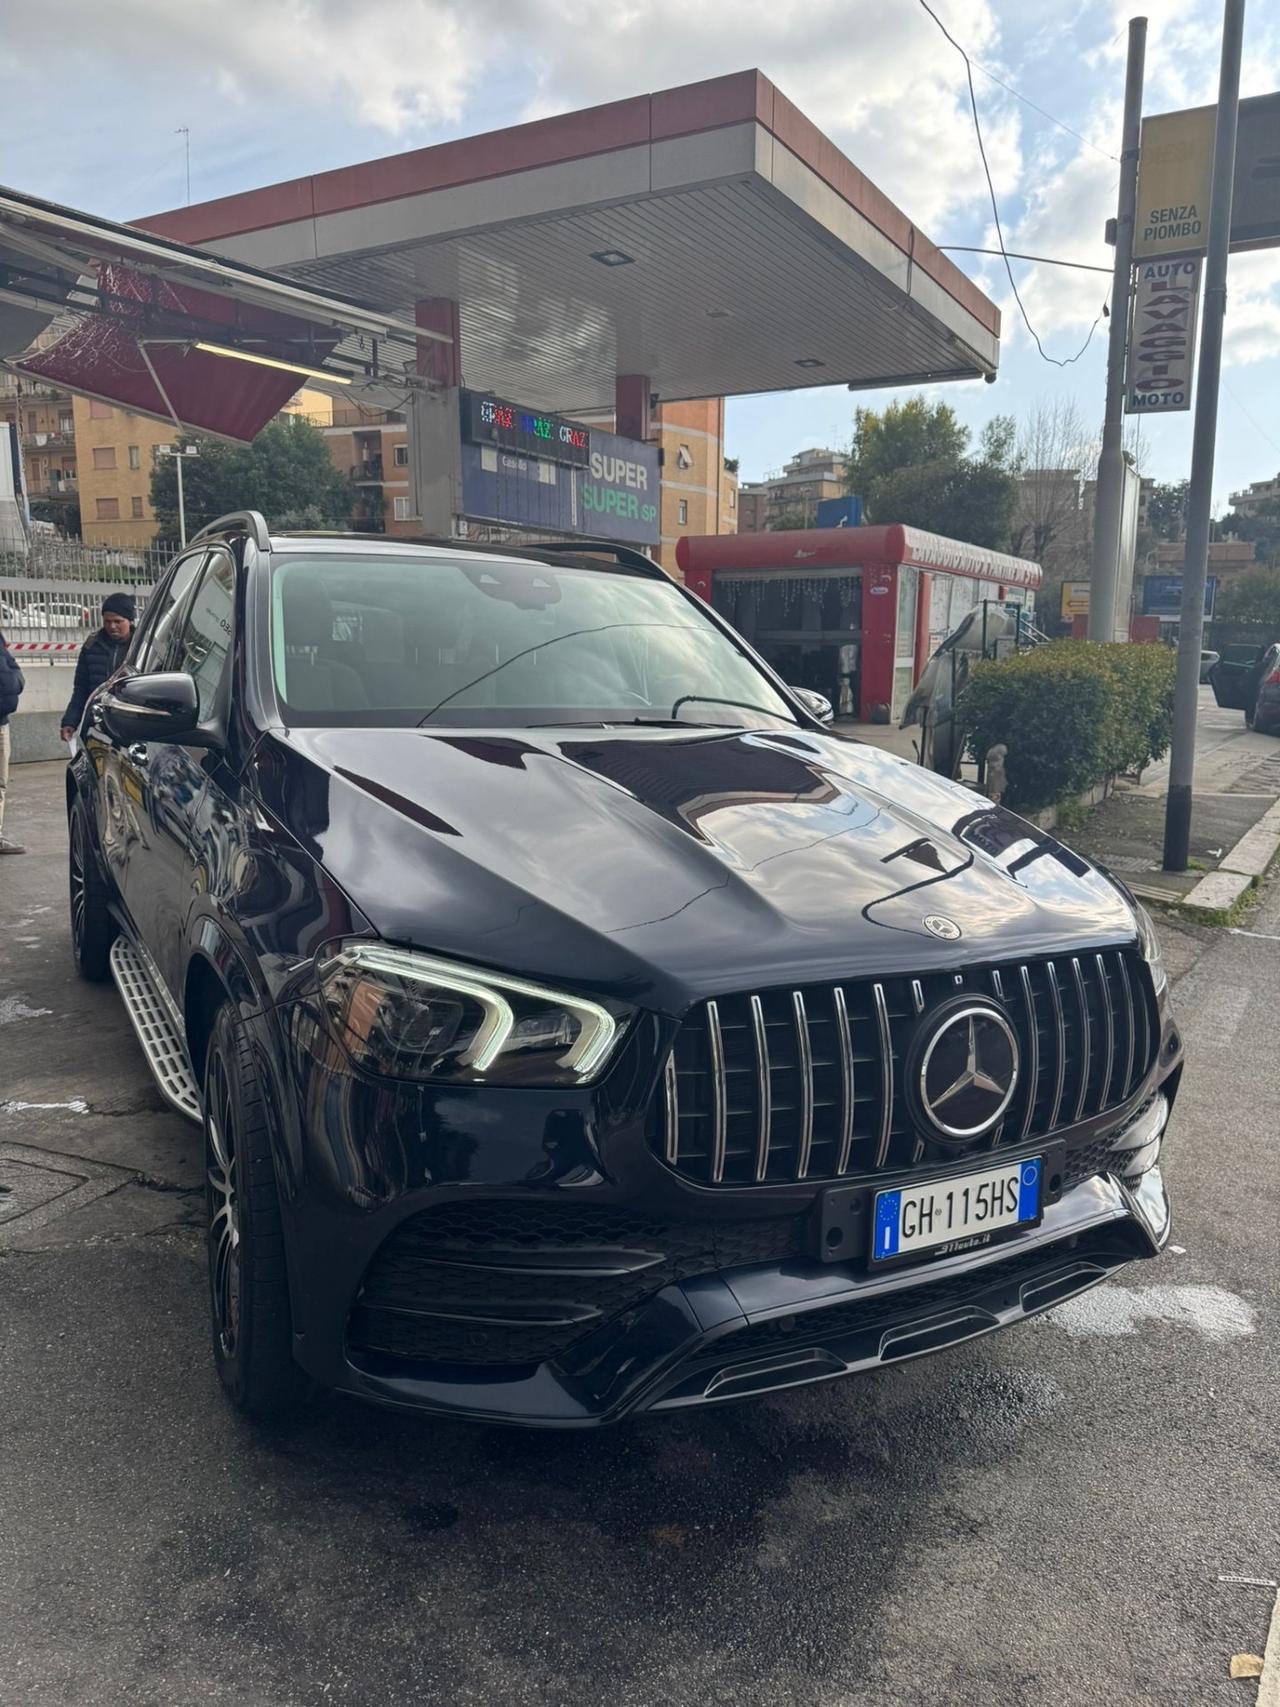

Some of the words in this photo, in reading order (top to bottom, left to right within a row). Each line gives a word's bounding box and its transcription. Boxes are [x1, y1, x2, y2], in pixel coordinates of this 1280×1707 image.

[1150, 204, 1198, 224] SENZA
[1143, 220, 1201, 241] PIOMBO
[1144, 262, 1196, 280] AUTO
[1135, 281, 1189, 393] LAVAGGIO
[1132, 391, 1185, 407] MOTO
[590, 452, 648, 491] SUPER
[582, 483, 639, 519] SUPER
[641, 504, 656, 523] SP
